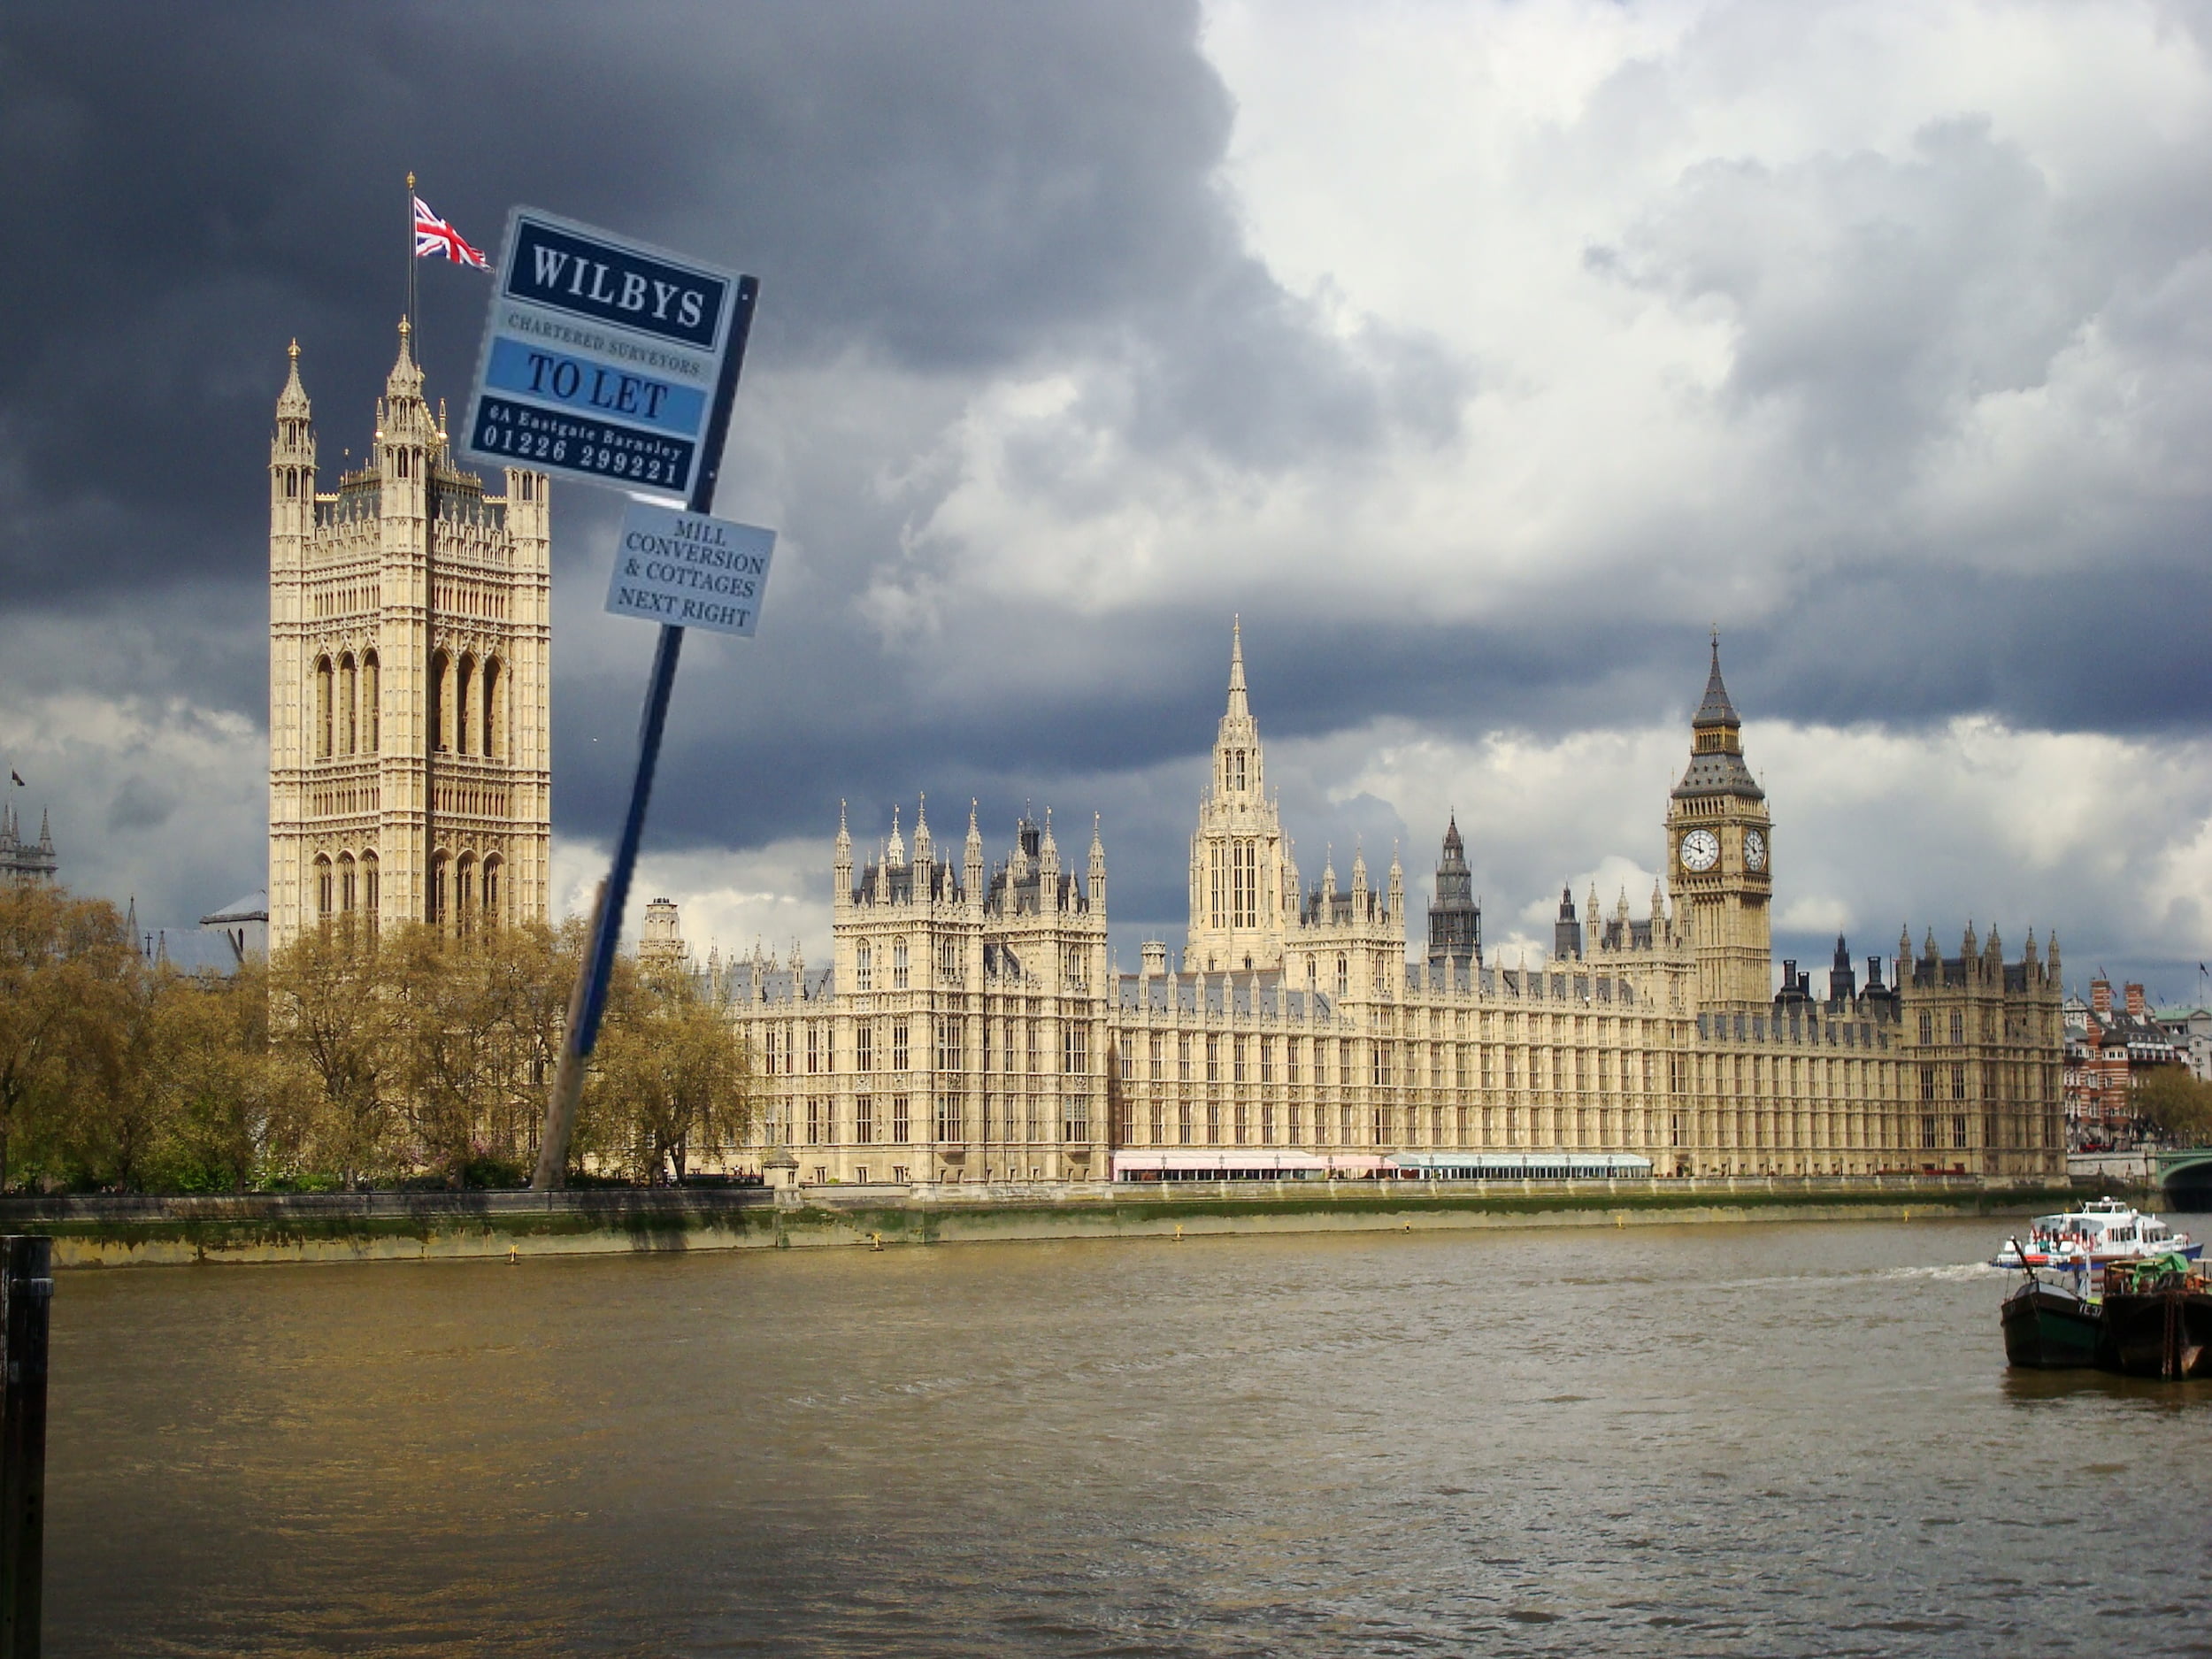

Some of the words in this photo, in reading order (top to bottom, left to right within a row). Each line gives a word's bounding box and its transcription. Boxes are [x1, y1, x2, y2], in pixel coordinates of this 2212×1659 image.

[533, 244, 703, 327] WILBYS
[508, 314, 604, 351] CHARTERED
[609, 340, 700, 375] SURVEYORS
[528, 353, 580, 398] TO
[588, 369, 667, 419] LET
[484, 425, 567, 462] 01226
[579, 444, 676, 485] 299221
[518, 411, 595, 442] Eastgate
[603, 429, 682, 461] Barnsley
[626, 533, 764, 574] CONVERSION
[674, 519, 726, 547] MILL
[625, 558, 639, 576] &
[646, 561, 756, 597] COTTAGES
[618, 587, 677, 613] NEXT
[680, 598, 750, 627] RIGHT
